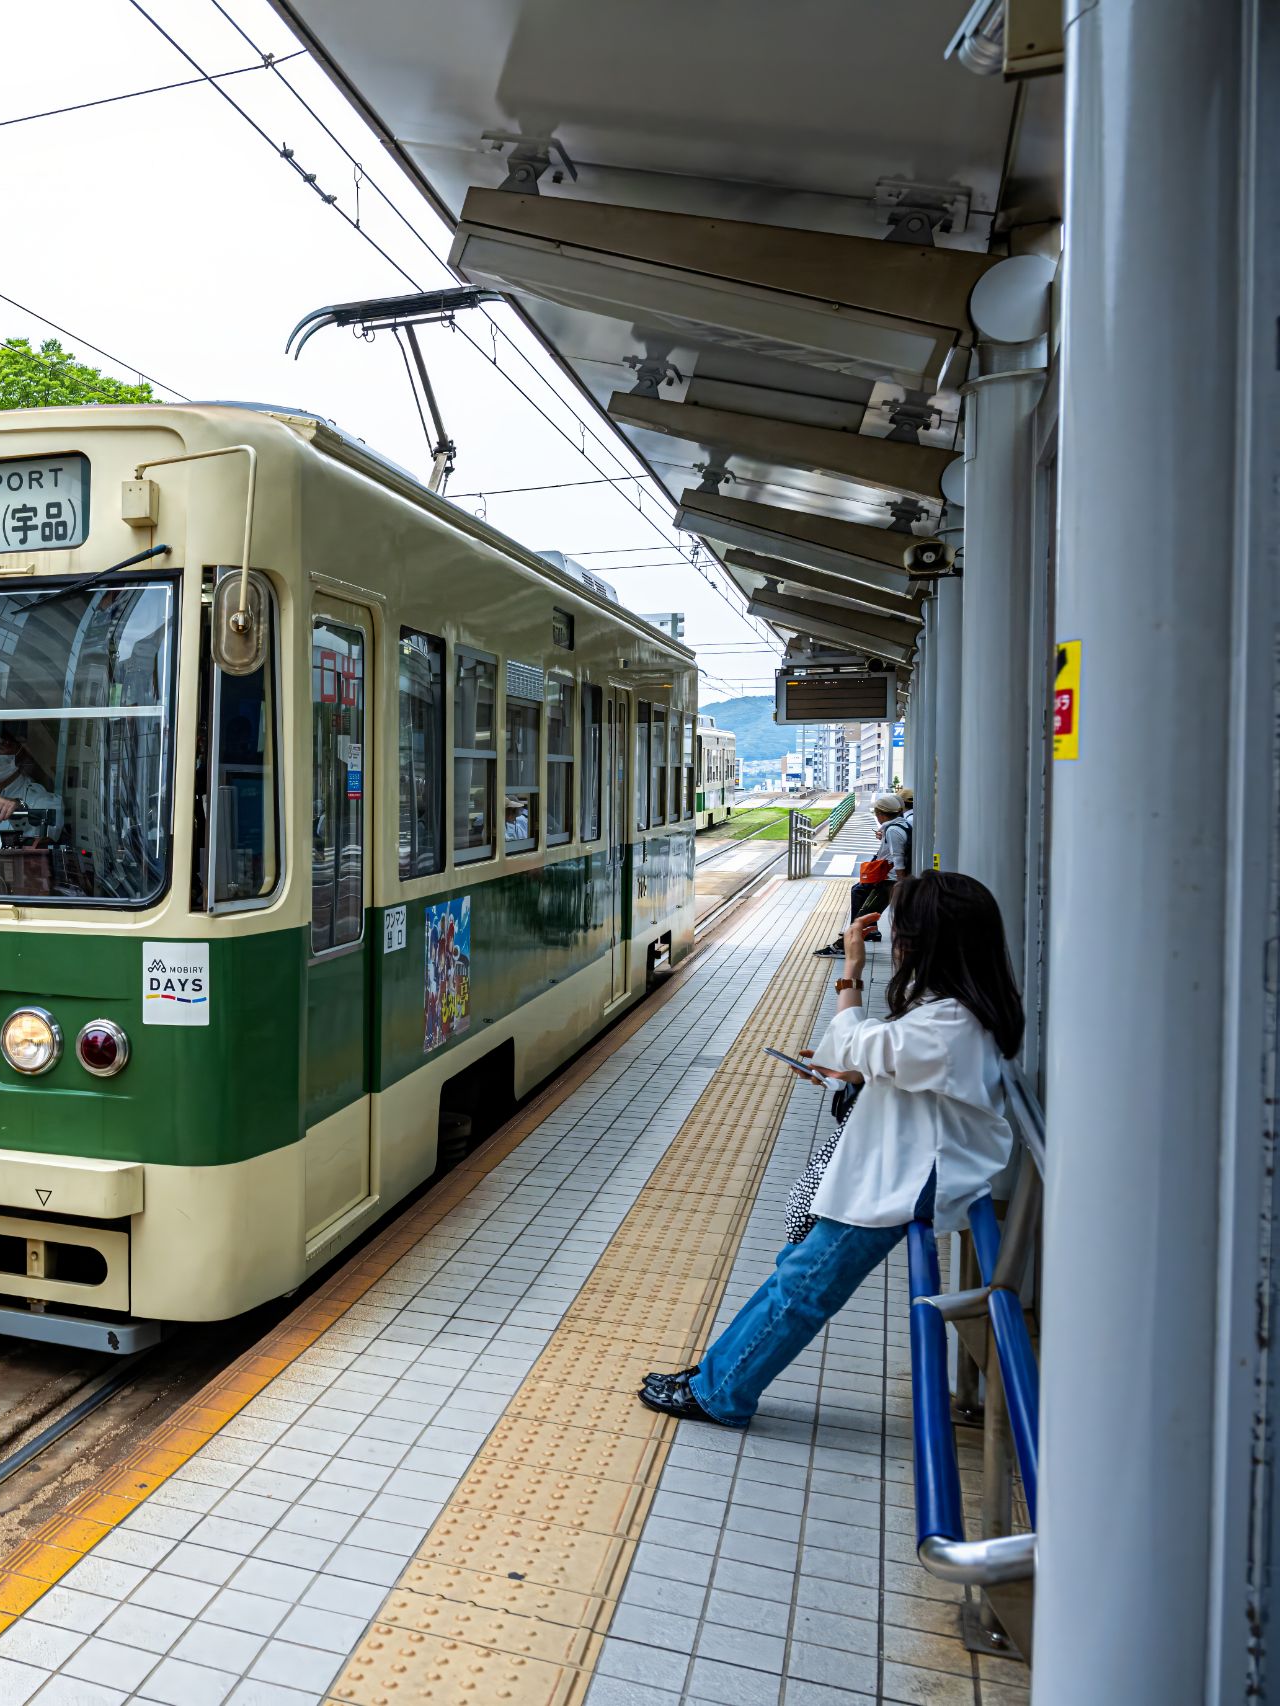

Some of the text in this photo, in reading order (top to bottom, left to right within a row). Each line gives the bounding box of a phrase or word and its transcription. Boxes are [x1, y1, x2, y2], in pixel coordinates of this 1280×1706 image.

[385, 910, 406, 930] ワンマン
[387, 930, 403, 949] 出口
[169, 966, 204, 974] MOBIRY
[149, 977, 203, 992] DAYS
